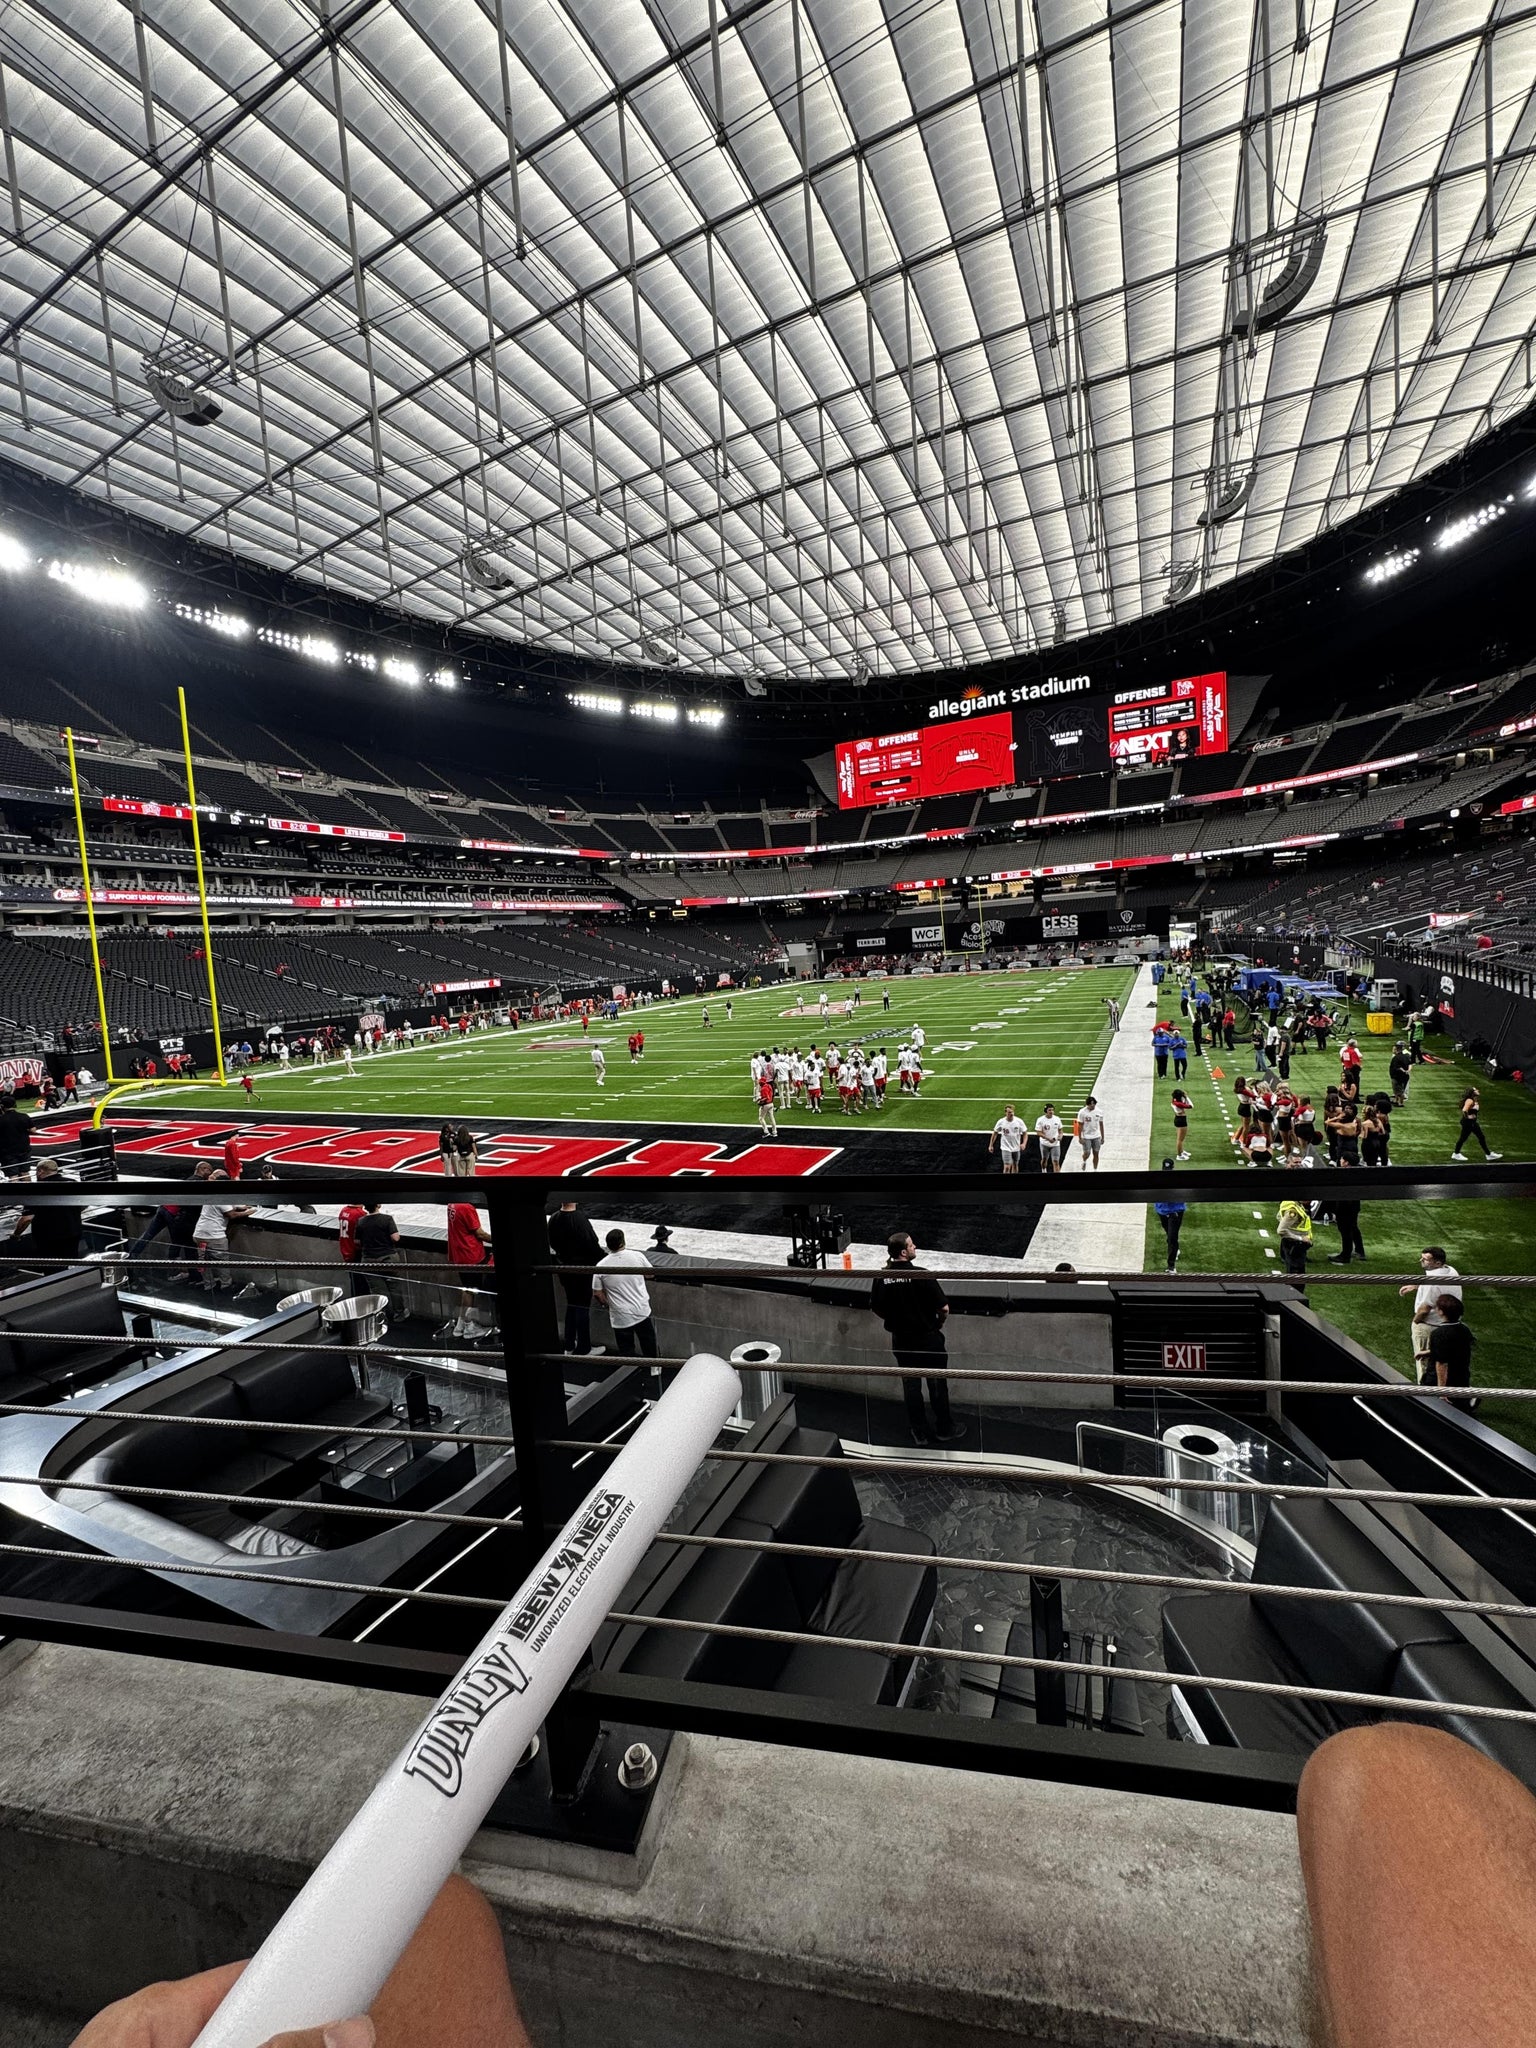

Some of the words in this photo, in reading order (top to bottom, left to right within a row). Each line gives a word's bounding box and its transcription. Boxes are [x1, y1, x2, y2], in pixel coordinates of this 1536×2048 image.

[928, 689, 1006, 718] allegiant
[1011, 675, 1091, 703] stadium
[1114, 685, 1167, 704] OFFENSE
[878, 732, 919, 748] OFFENSE
[1050, 729, 1083, 740] MEMPHIS
[1120, 730, 1173, 755] NEXT
[1206, 720, 1214, 742] FIRST
[1042, 914, 1079, 929] CESS
[914, 929, 940, 940] WCF
[1163, 1344, 1204, 1369] EXIT
[507, 1572, 562, 1641] IBEW
[572, 1493, 627, 1550] NECA
[531, 1597, 572, 1654] UNIONIZED
[568, 1544, 610, 1597] ELECTRICAL
[605, 1500, 637, 1544] INDUSTRY
[403, 1641, 531, 1798] UNLV
